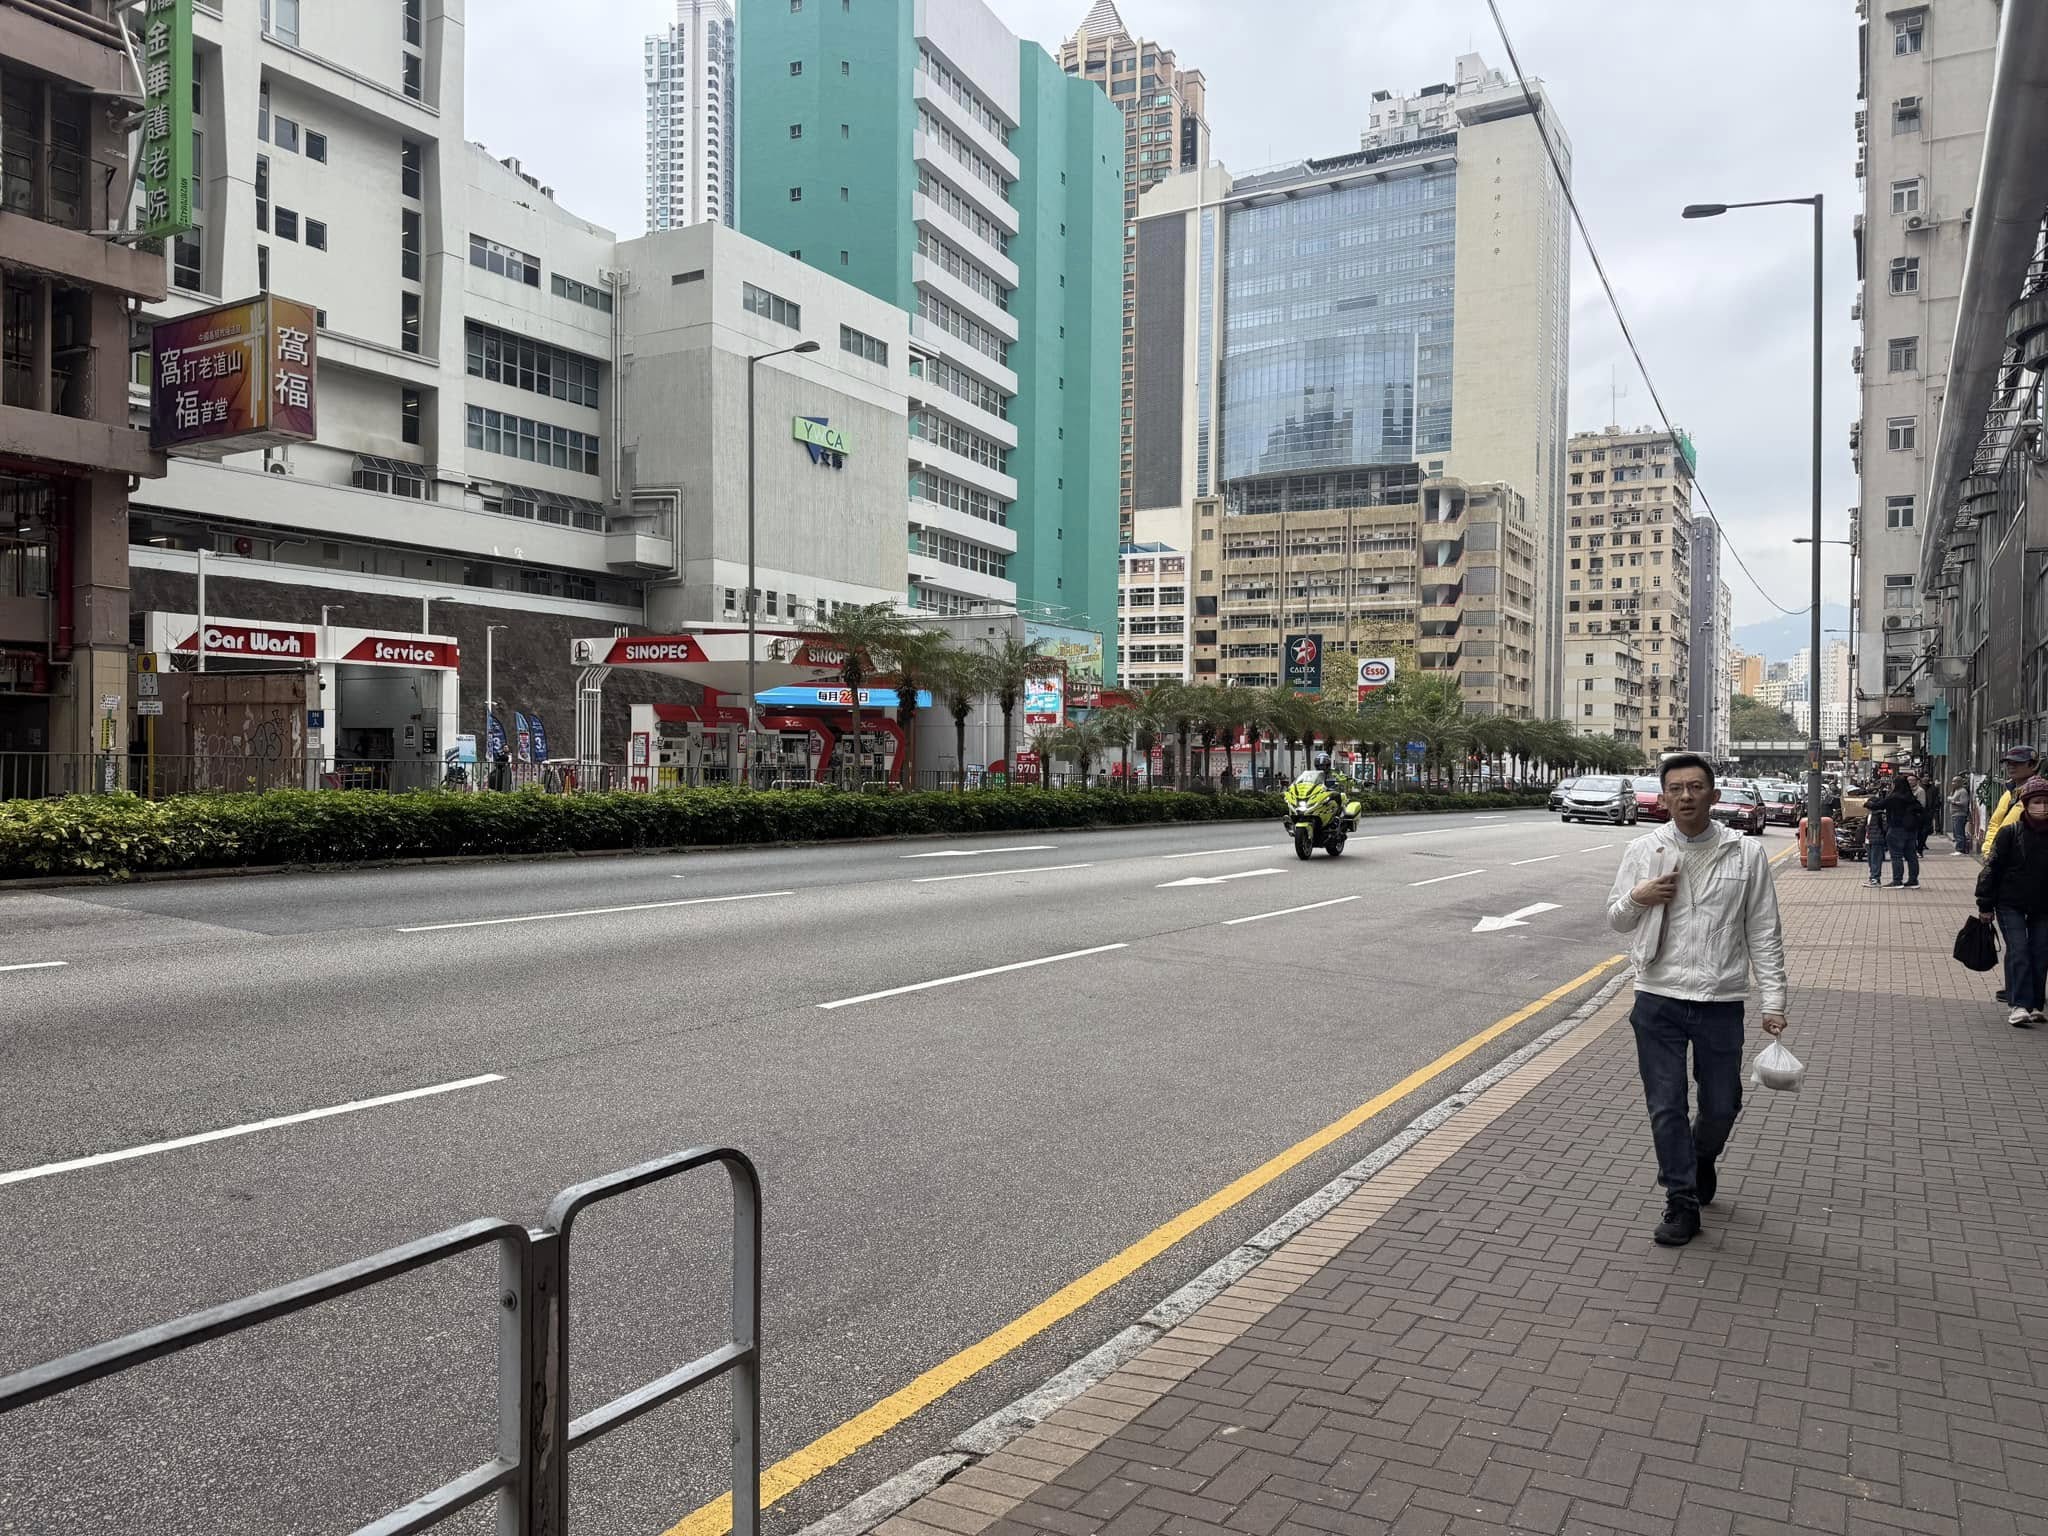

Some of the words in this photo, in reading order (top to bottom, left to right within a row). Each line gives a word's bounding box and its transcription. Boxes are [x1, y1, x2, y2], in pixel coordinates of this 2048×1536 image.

[147, 19, 170, 226] 金華護老院
[160, 347, 242, 389] 窩打老道山
[275, 326, 310, 410] 窩福
[176, 390, 229, 430] 福音堂
[203, 629, 245, 650] Car
[250, 632, 301, 653] Wash
[375, 642, 435, 662] Service
[626, 644, 688, 660] SINOPEC
[808, 650, 850, 664] SINOP
[1365, 666, 1386, 676] Esso
